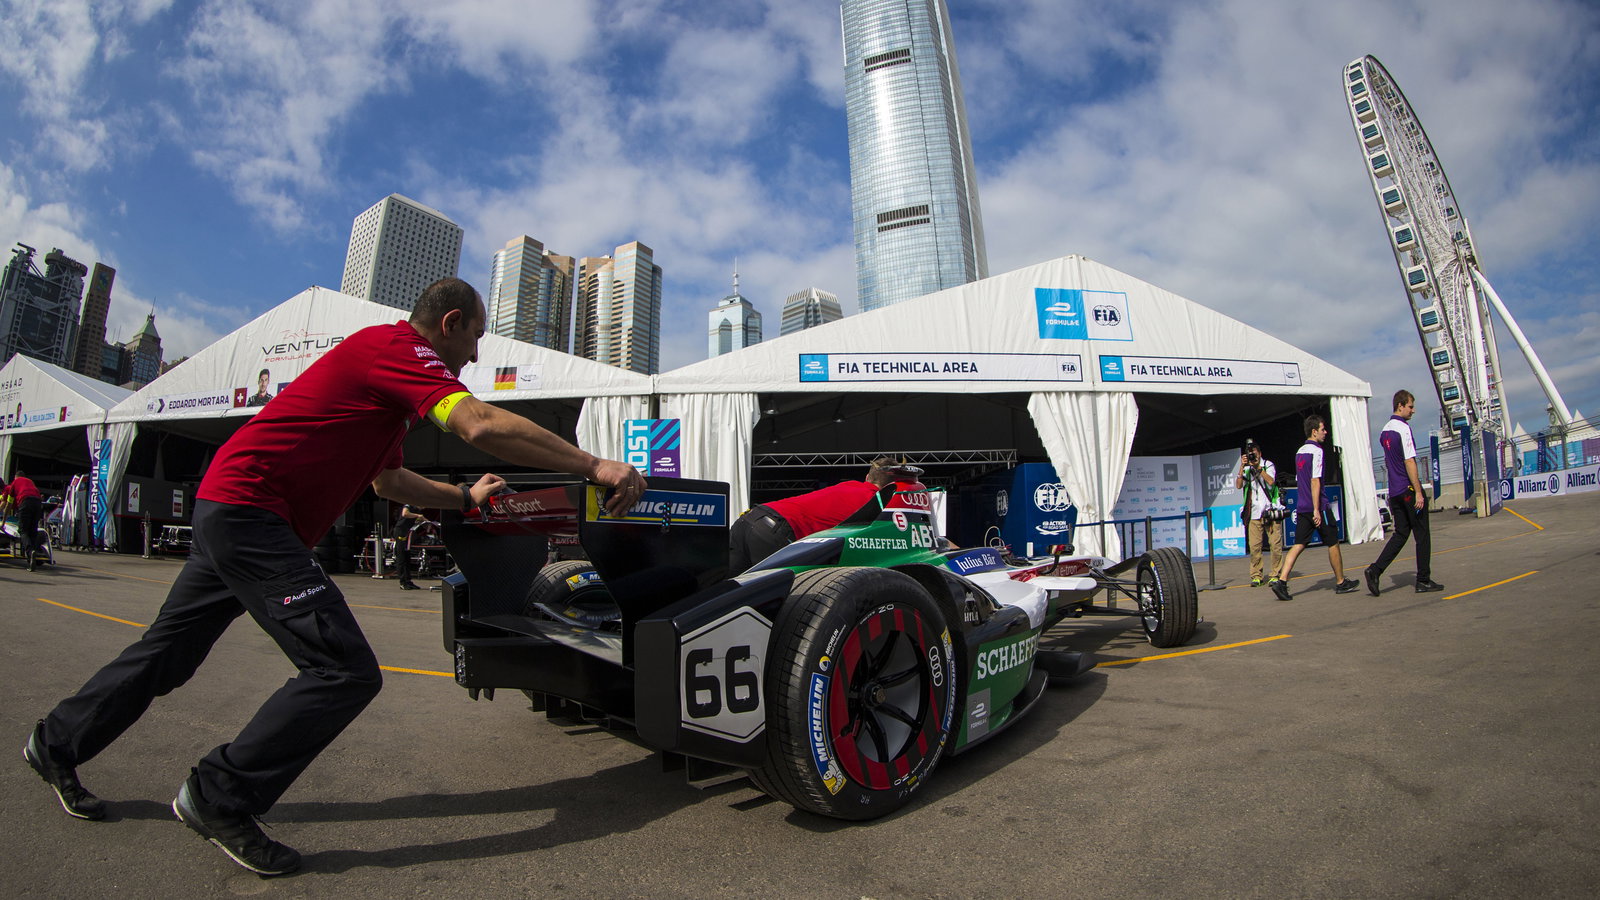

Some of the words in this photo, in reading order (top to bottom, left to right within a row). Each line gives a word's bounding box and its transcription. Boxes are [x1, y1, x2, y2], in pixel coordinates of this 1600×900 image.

[262, 336, 345, 355] VENTUR
[838, 363, 859, 373] FIA
[863, 362, 939, 373] TECHNICAL
[943, 362, 978, 373] AREA
[1131, 365, 1148, 375] FIA
[1150, 365, 1206, 377] TECHNICAL
[1207, 367, 1233, 377] AREA
[169, 399, 197, 410] EDOARDO
[197, 395, 230, 407] MORTARA
[440, 398, 450, 410] 20
[628, 420, 648, 476] OST
[1207, 472, 1235, 490] HKG
[1518, 480, 1547, 493] Allianz
[1566, 472, 1596, 488] Allianz
[509, 498, 546, 515] Sport
[848, 537, 909, 550] SCHAEFFLER
[955, 556, 984, 572] Julius
[981, 554, 996, 566] Bär
[292, 589, 307, 601] Audi
[307, 584, 327, 596] Sport
[685, 645, 760, 719] 66
[812, 678, 829, 762] MICHELIN
